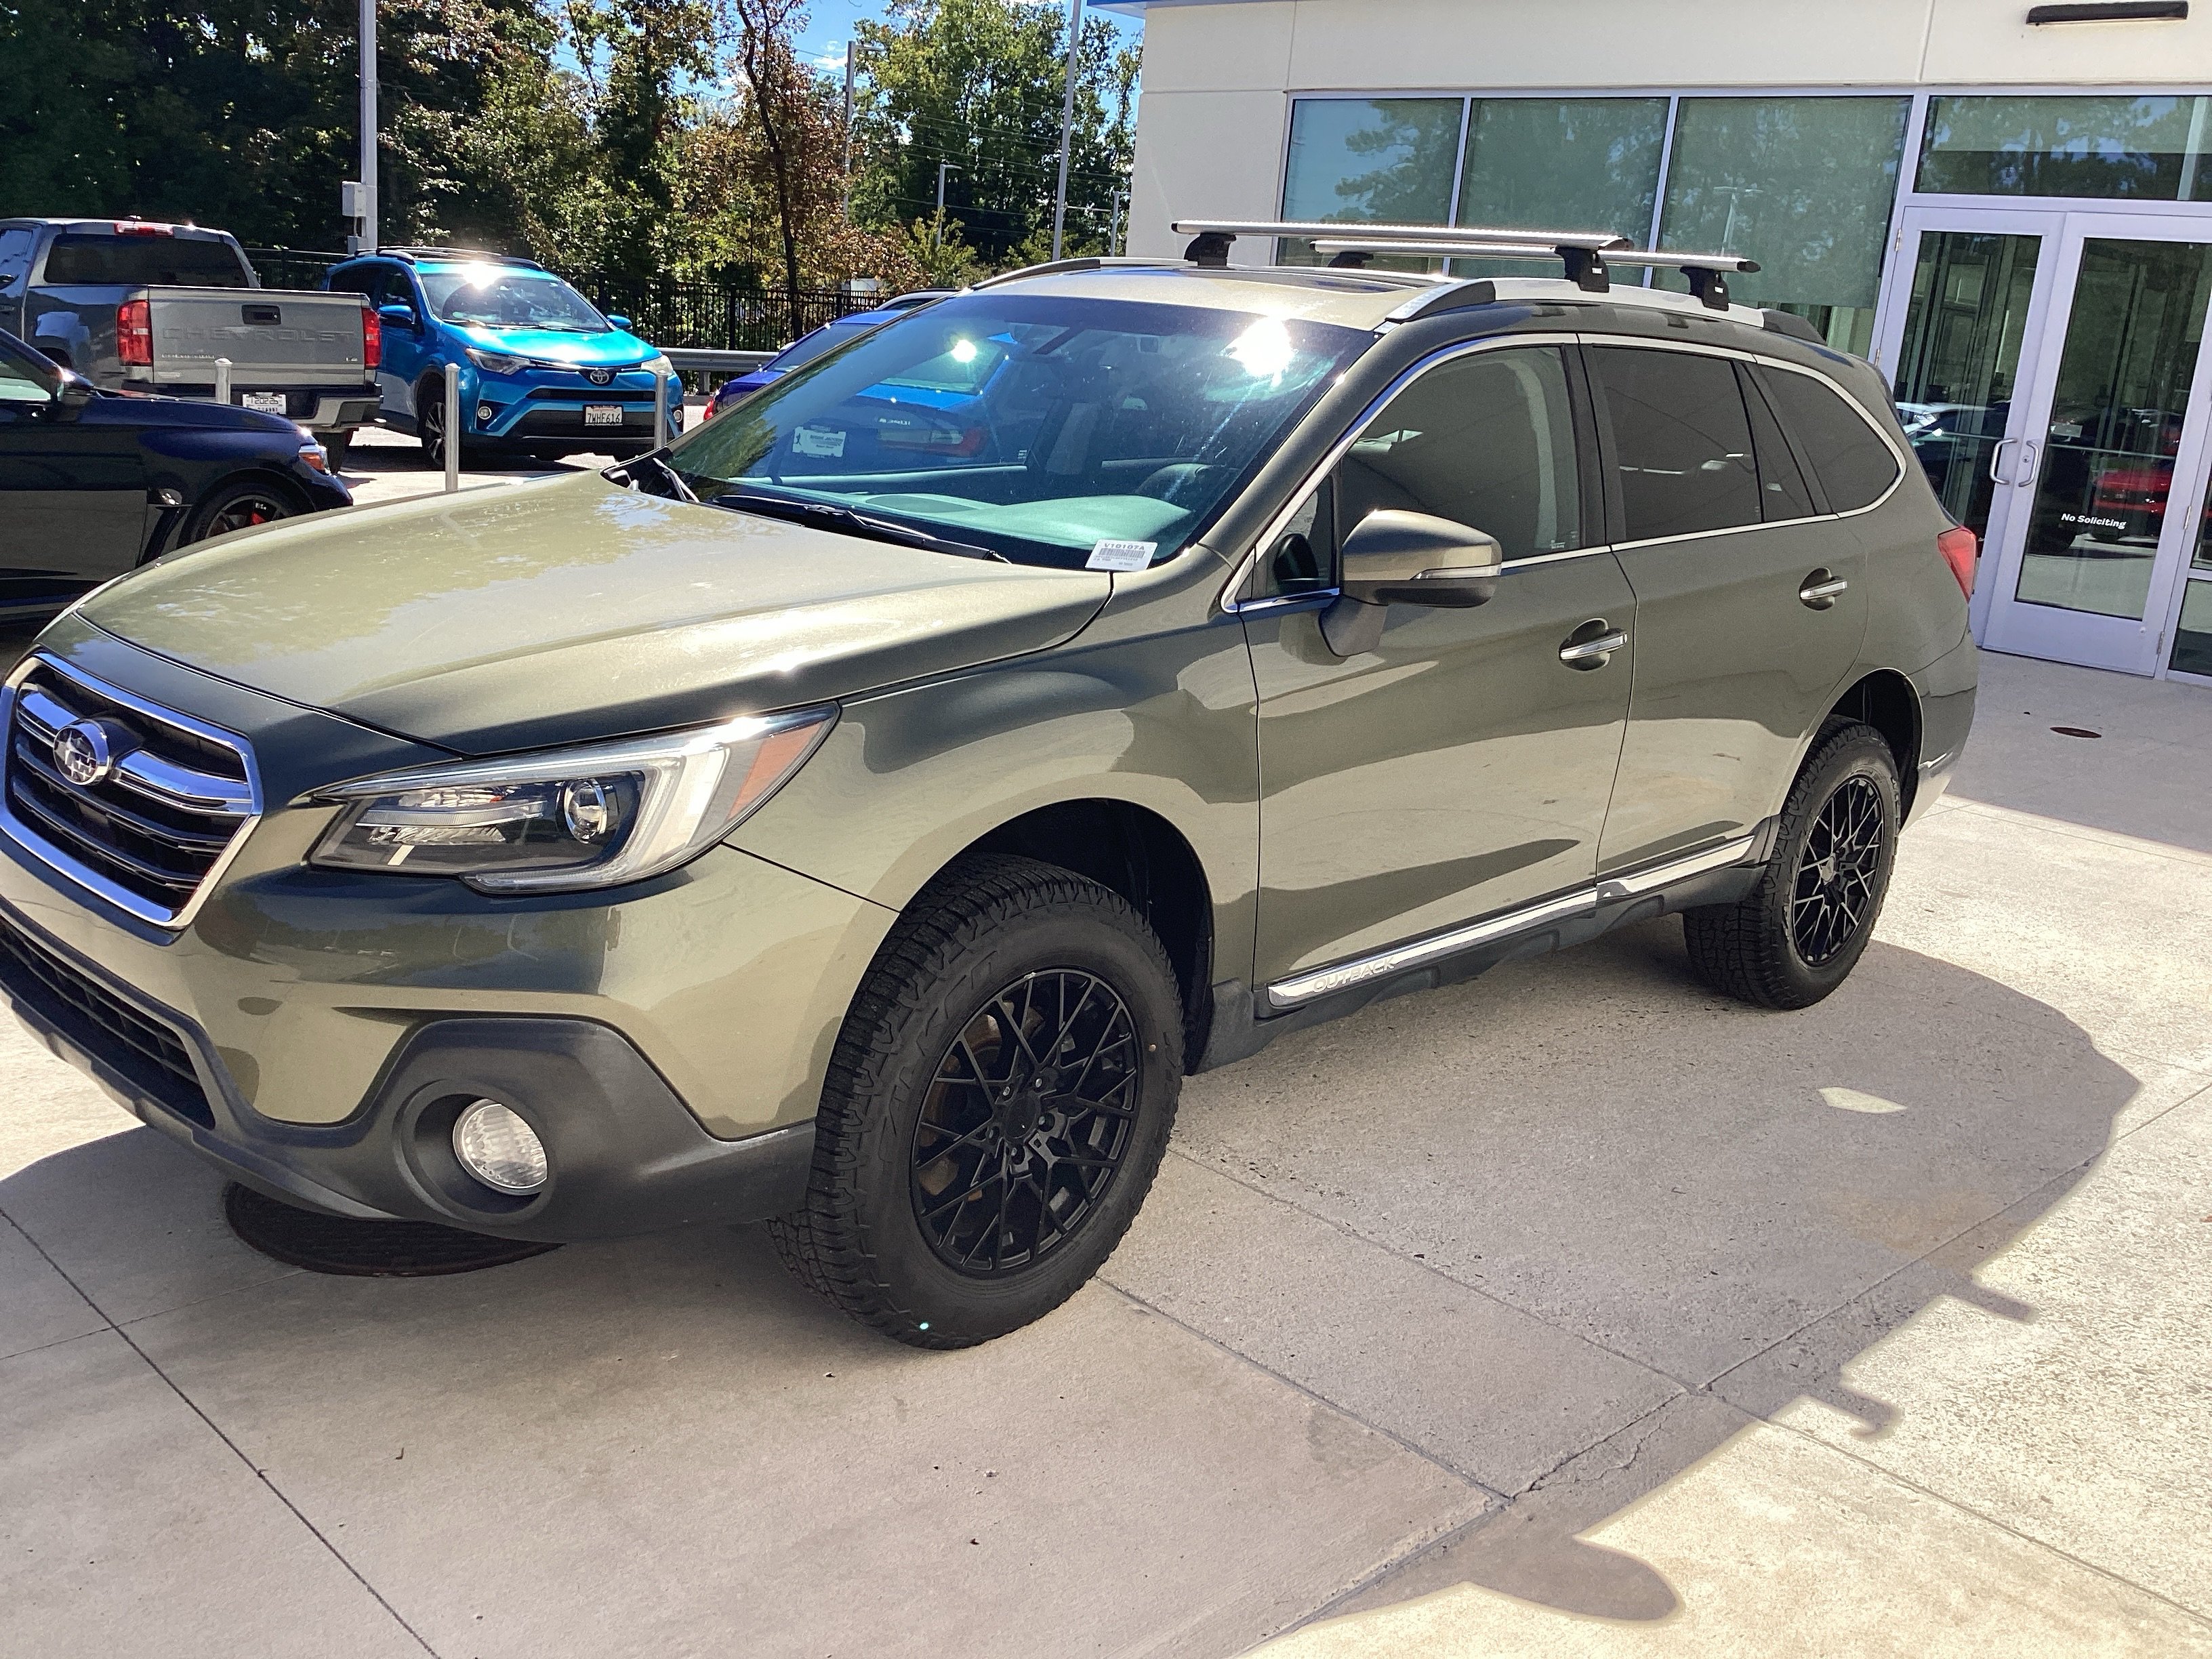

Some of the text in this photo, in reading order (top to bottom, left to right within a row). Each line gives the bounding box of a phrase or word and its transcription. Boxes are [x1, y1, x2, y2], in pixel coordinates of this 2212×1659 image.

[2061, 513, 2127, 530] No Soliciting
[1104, 543, 1145, 551] V10107A
[1313, 956, 1395, 993] OUTBACK
